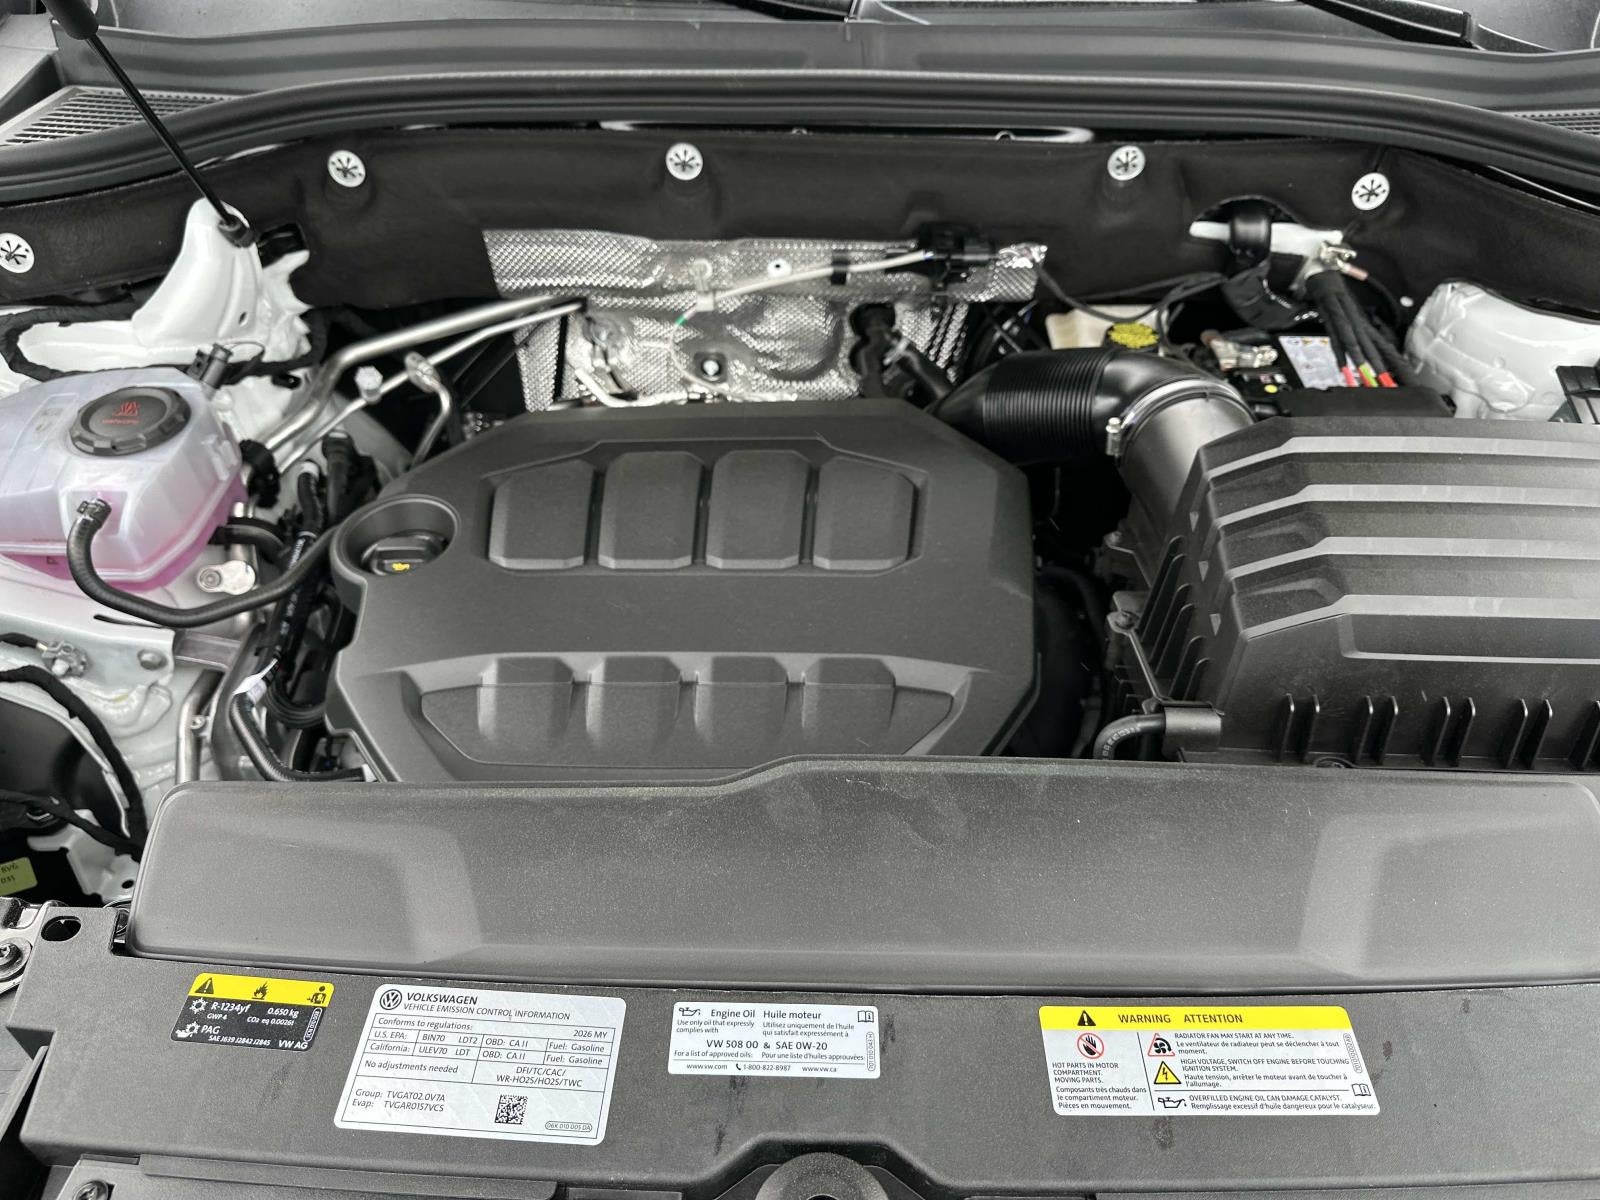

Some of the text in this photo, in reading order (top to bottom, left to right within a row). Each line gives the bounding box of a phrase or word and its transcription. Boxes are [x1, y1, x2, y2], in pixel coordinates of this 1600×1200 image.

[407, 992, 478, 1005] VOLKSWAGEN
[211, 1002, 299, 1018] R-1234yf 0.650 kg
[404, 1003, 570, 1020] VEHICLE EMISSION CONTROL INFORMATION
[711, 1009, 740, 1019] Engine
[743, 1010, 756, 1018] Oil
[764, 1010, 786, 1019] Huile
[378, 1017, 473, 1030] Conforms to regulations:
[1118, 1014, 1244, 1023] WARNING ATTENTION
[201, 1024, 220, 1034] PAG
[390, 1032, 408, 1040] EPA:
[422, 1034, 478, 1044] BIN70 LDT2
[573, 1030, 608, 1039] 2026 MY
[236, 1037, 252, 1045] J2842
[253, 1038, 271, 1046] J2845
[278, 1040, 308, 1050] VW AG
[486, 1038, 505, 1046] OBD:
[726, 1040, 743, 1048] 508
[796, 1042, 828, 1050] 0W-20
[370, 1043, 411, 1052] California:
[419, 1046, 470, 1056] ULEV70 LDT
[549, 1042, 604, 1052] Fuel: Gasoline
[482, 1050, 517, 1060] OBD: CA
[569, 1056, 602, 1065] Gasoline
[365, 1060, 458, 1073] No adjustments needed
[516, 1066, 567, 1077] DFI/TC/CAC/
[356, 1089, 383, 1098] Group:
[352, 1099, 374, 1108] Evap:
